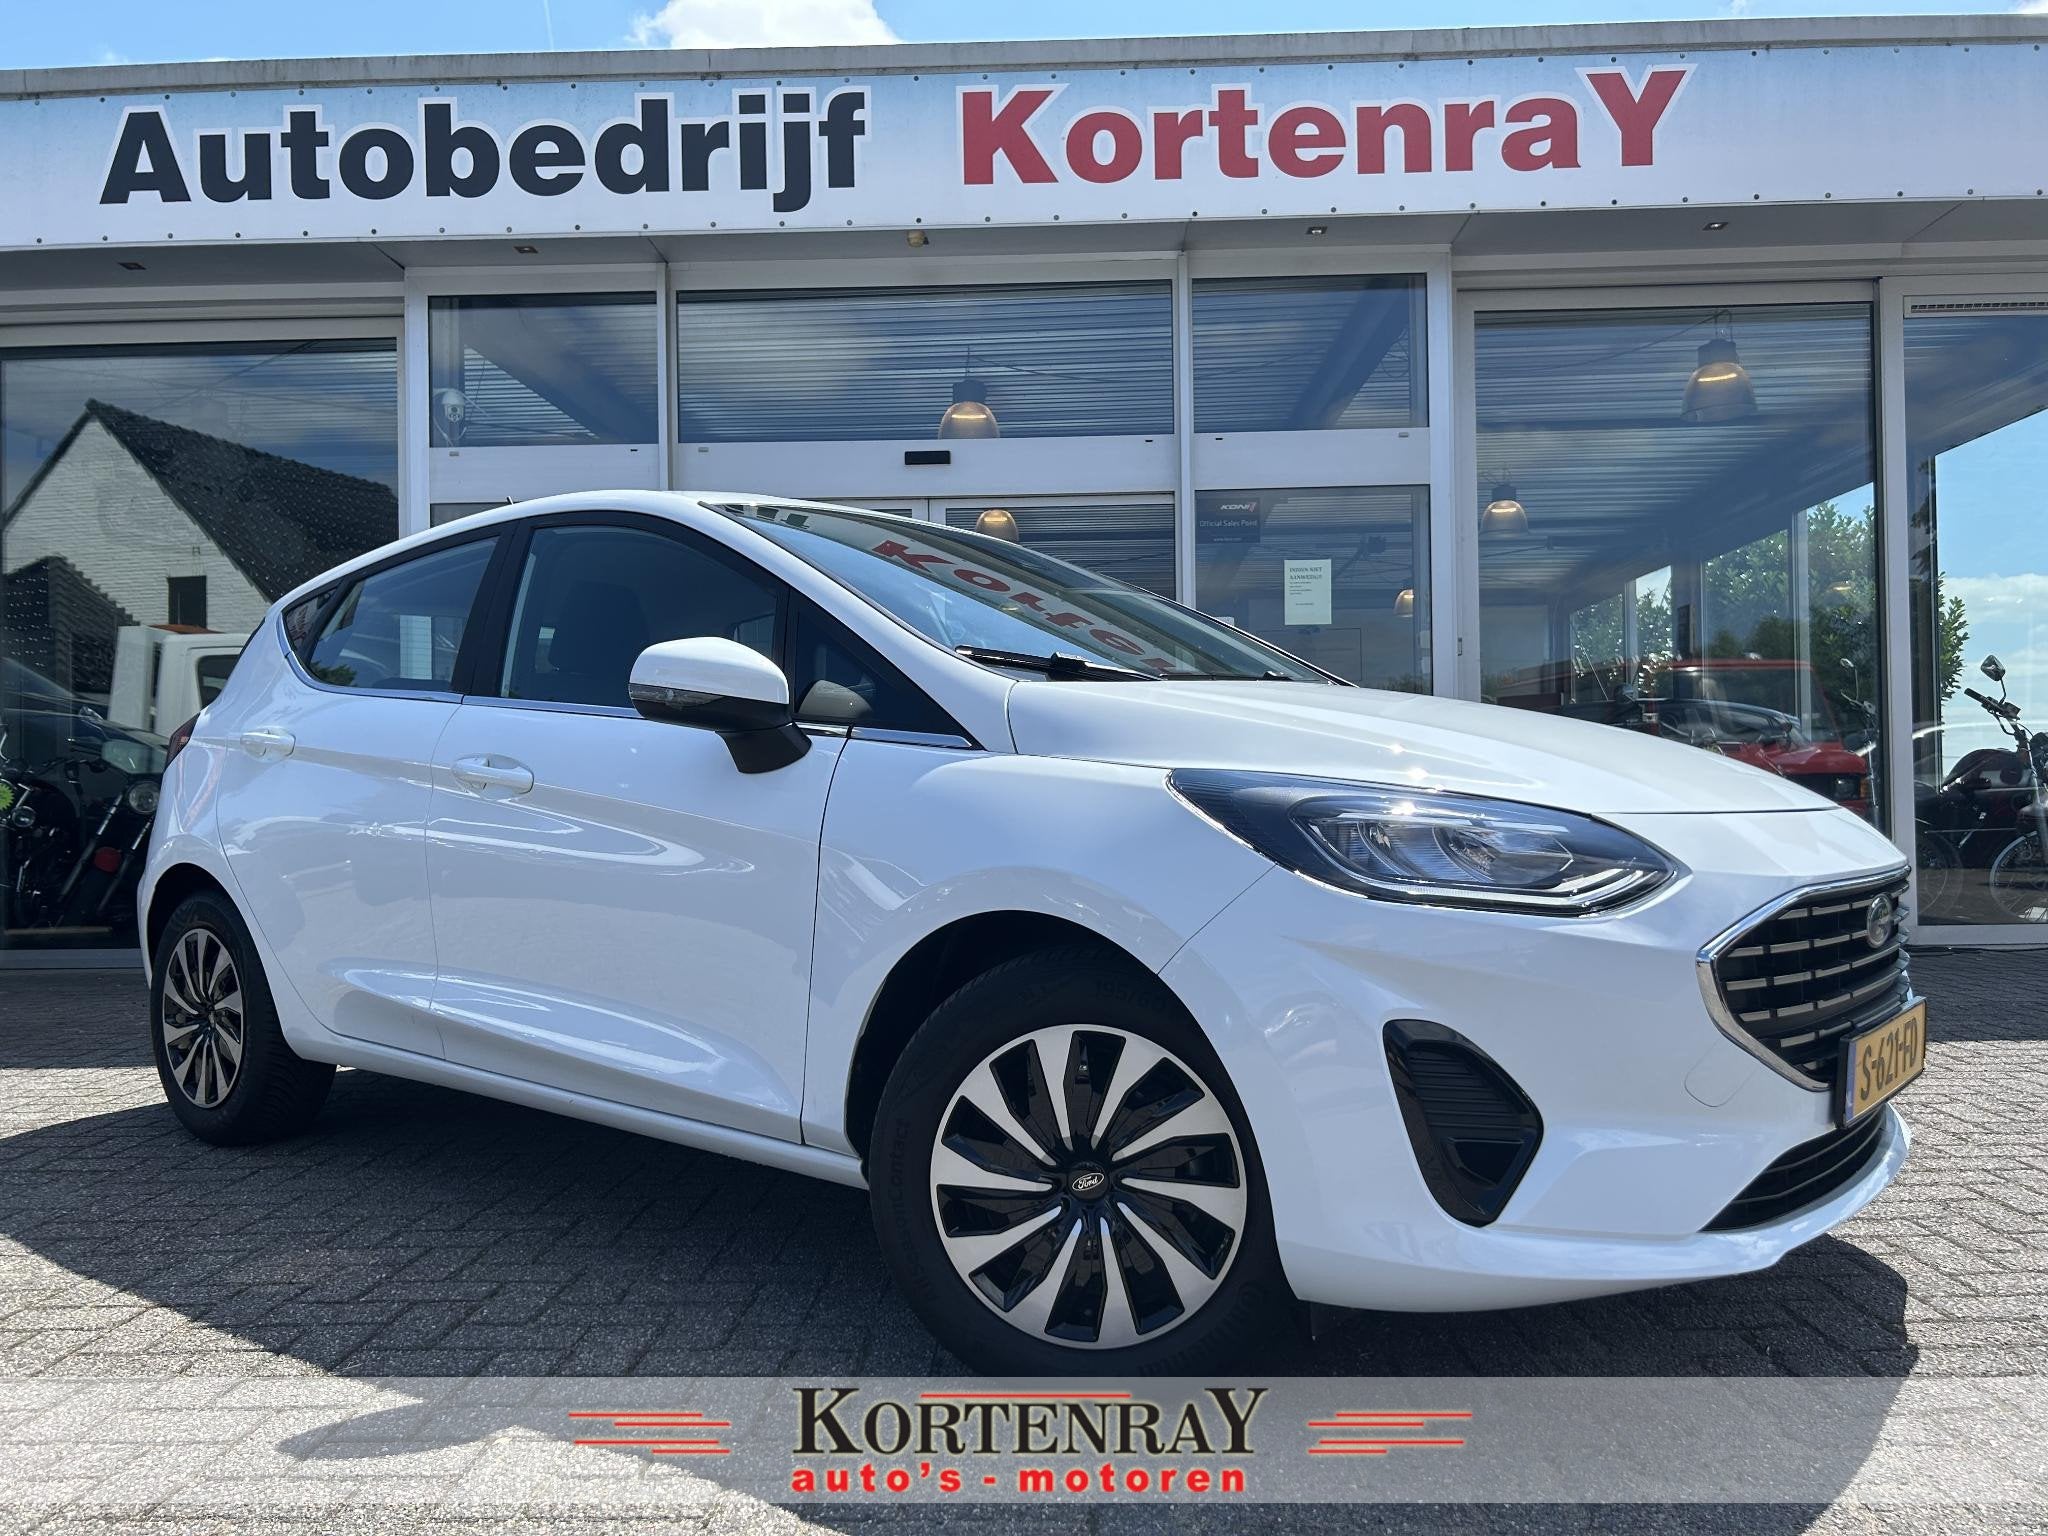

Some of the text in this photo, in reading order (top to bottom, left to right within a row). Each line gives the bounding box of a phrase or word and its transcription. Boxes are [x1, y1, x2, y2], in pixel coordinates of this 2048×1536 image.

[99, 69, 1687, 213] Autobedrijf KortenraY
[1860, 1016, 1918, 1101] S-621-FD
[1077, 1175, 1099, 1189] Ford
